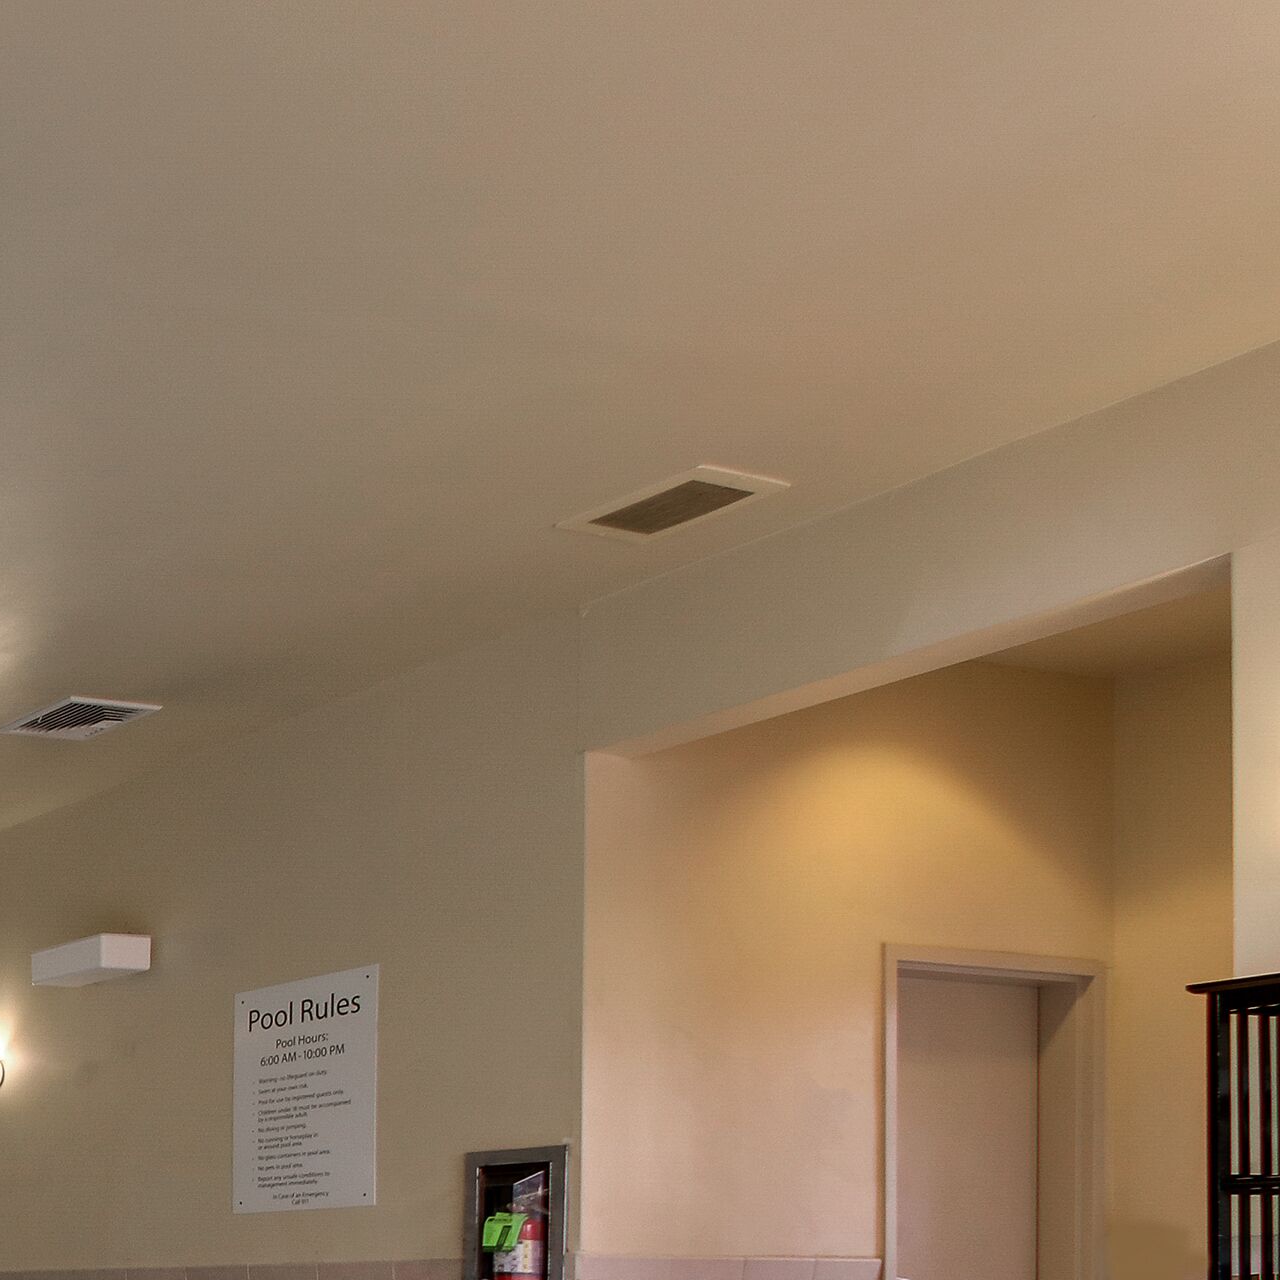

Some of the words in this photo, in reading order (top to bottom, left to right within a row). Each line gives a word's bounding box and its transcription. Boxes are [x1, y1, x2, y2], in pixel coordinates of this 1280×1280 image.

[248, 1001, 293, 1033] Pool
[301, 993, 361, 1023] Rules
[275, 1036, 296, 1049] Pool
[298, 1033, 329, 1045] Hours:
[260, 1054, 280, 1067] 6:00
[281, 1052, 297, 1064] AM
[303, 1046, 327, 1060] 10:00
[329, 1043, 346, 1056] PM
